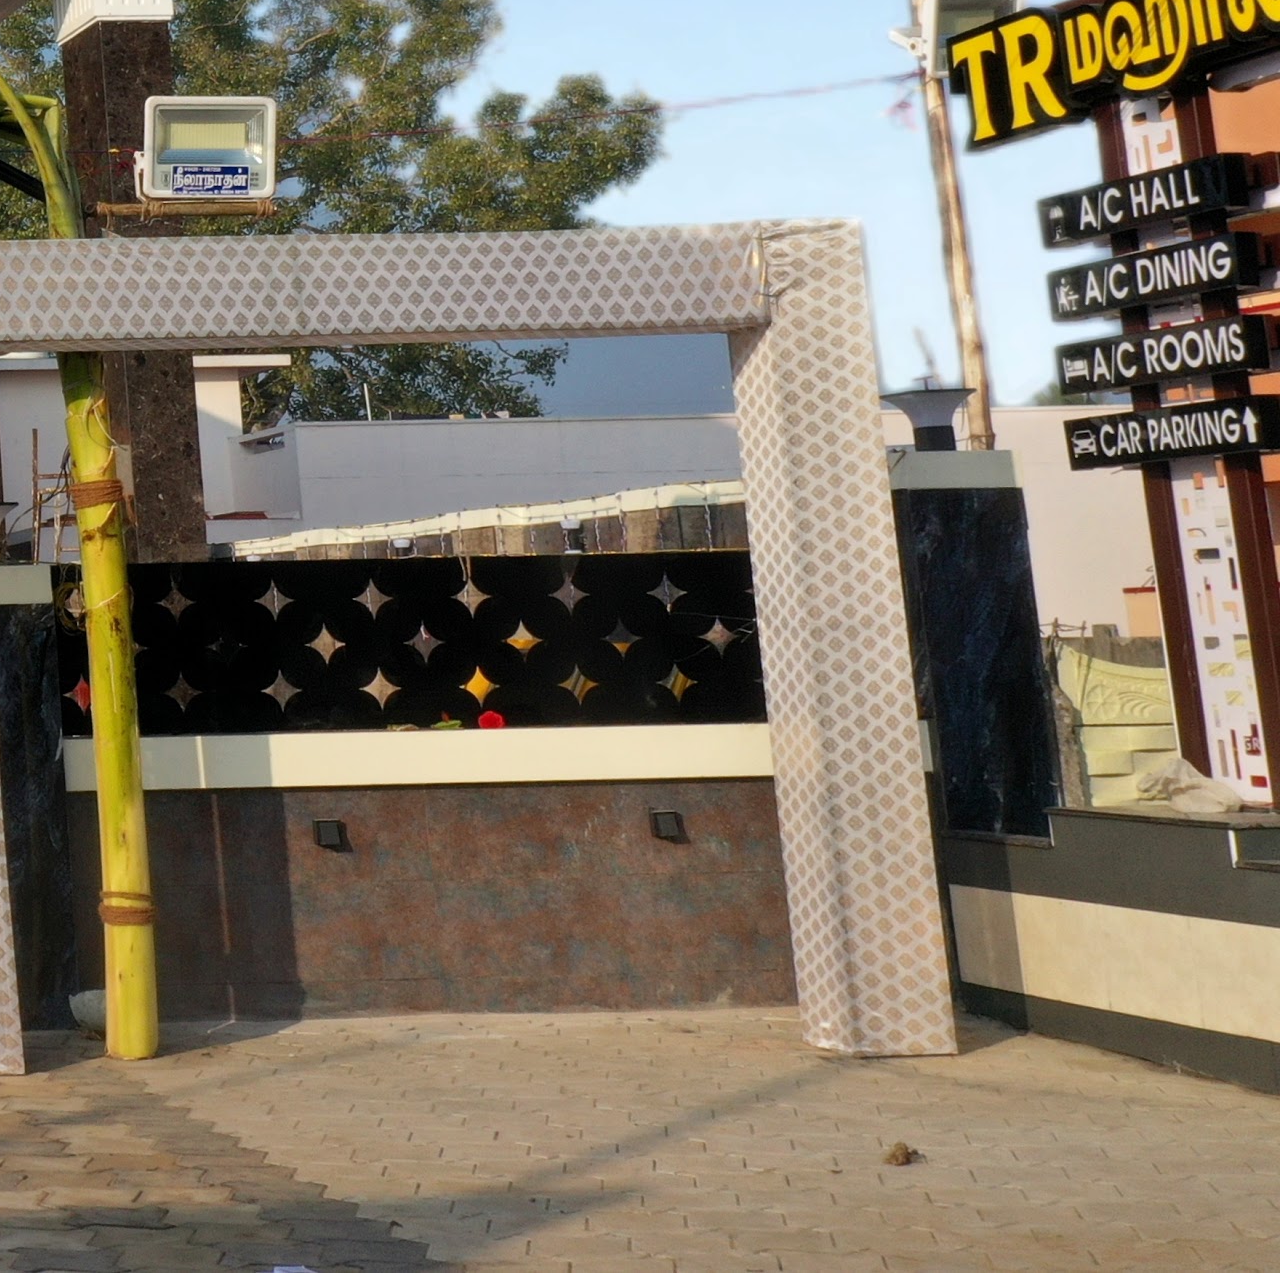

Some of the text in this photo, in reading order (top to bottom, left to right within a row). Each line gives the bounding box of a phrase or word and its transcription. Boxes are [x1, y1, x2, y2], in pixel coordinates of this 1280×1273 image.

[951, 15, 1067, 141] TR
[1080, 169, 1200, 231] A/C HALL
[1085, 241, 1231, 306] A/C DINING
[1093, 323, 1245, 384] A/C ROOMS
[1099, 407, 1241, 457] CAR PARKING
